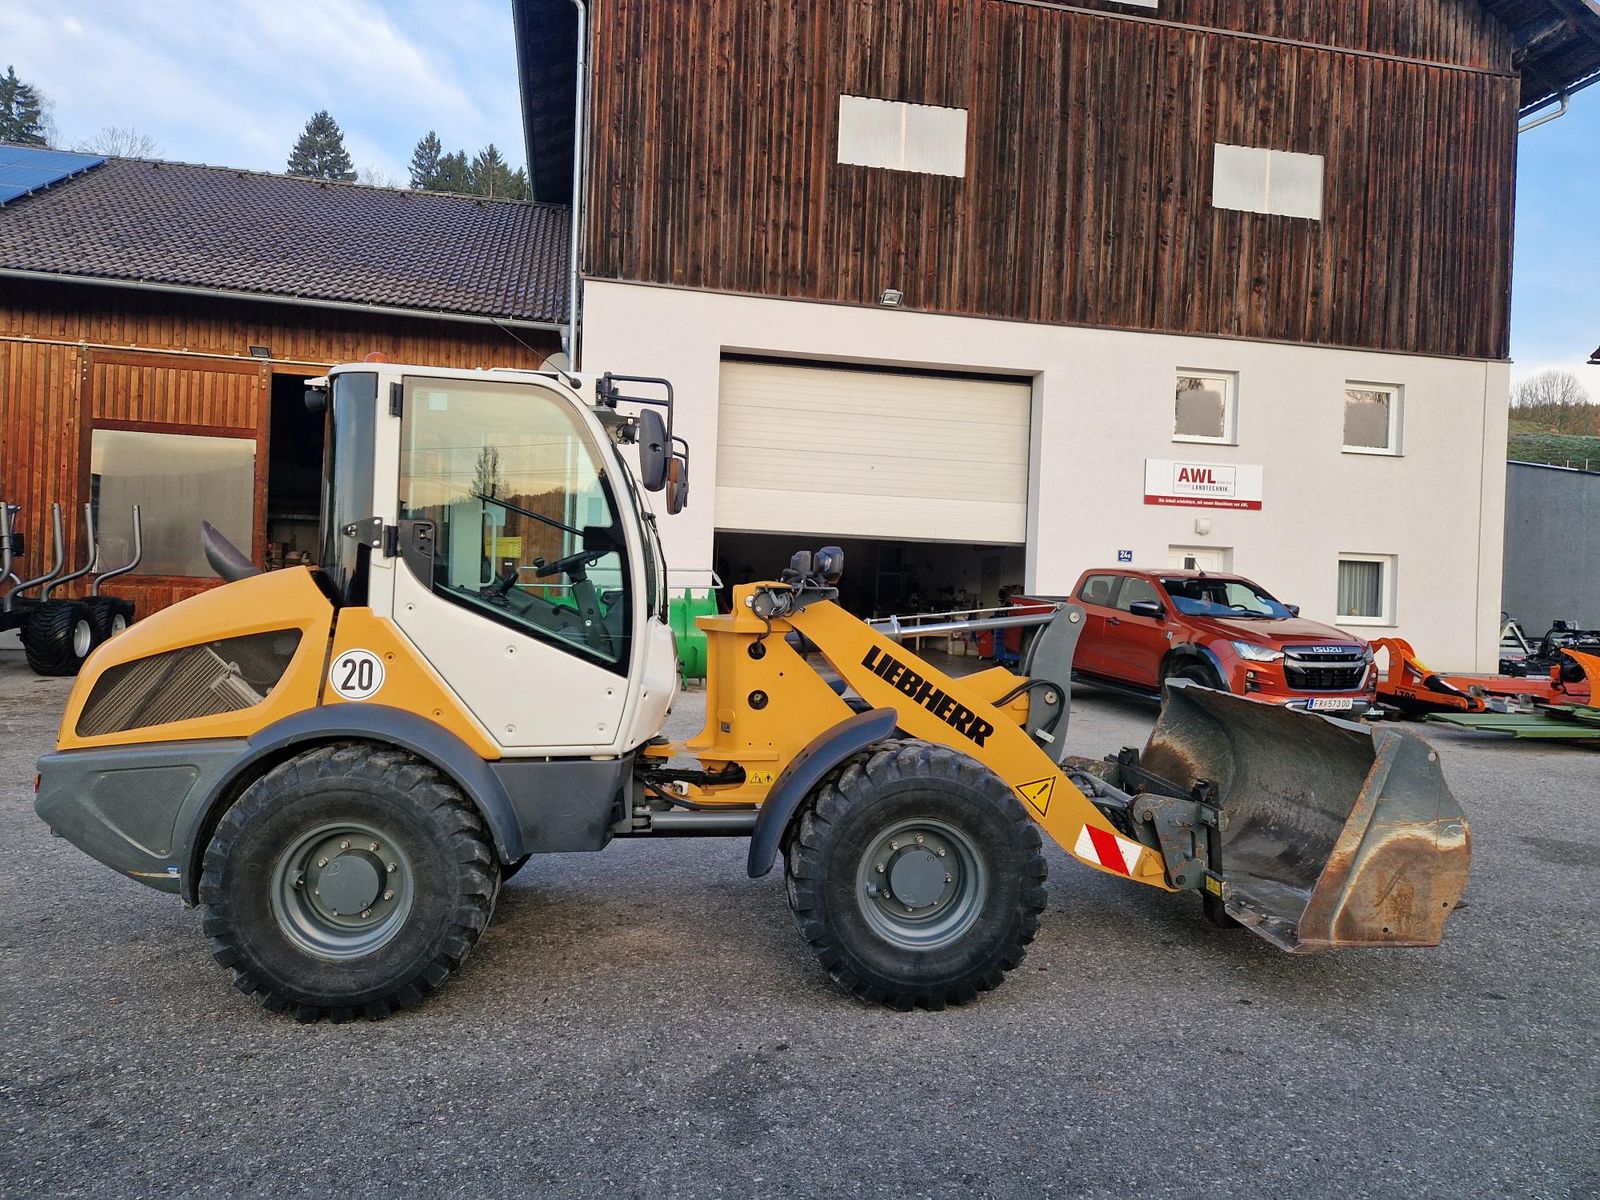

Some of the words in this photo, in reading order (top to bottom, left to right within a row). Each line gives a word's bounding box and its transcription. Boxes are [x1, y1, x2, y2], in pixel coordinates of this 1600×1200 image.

[1178, 467, 1216, 484] AWL
[1192, 484, 1228, 492] LANDTECHNIK
[341, 658, 374, 691] 20
[861, 644, 994, 748] LIEBHERR
